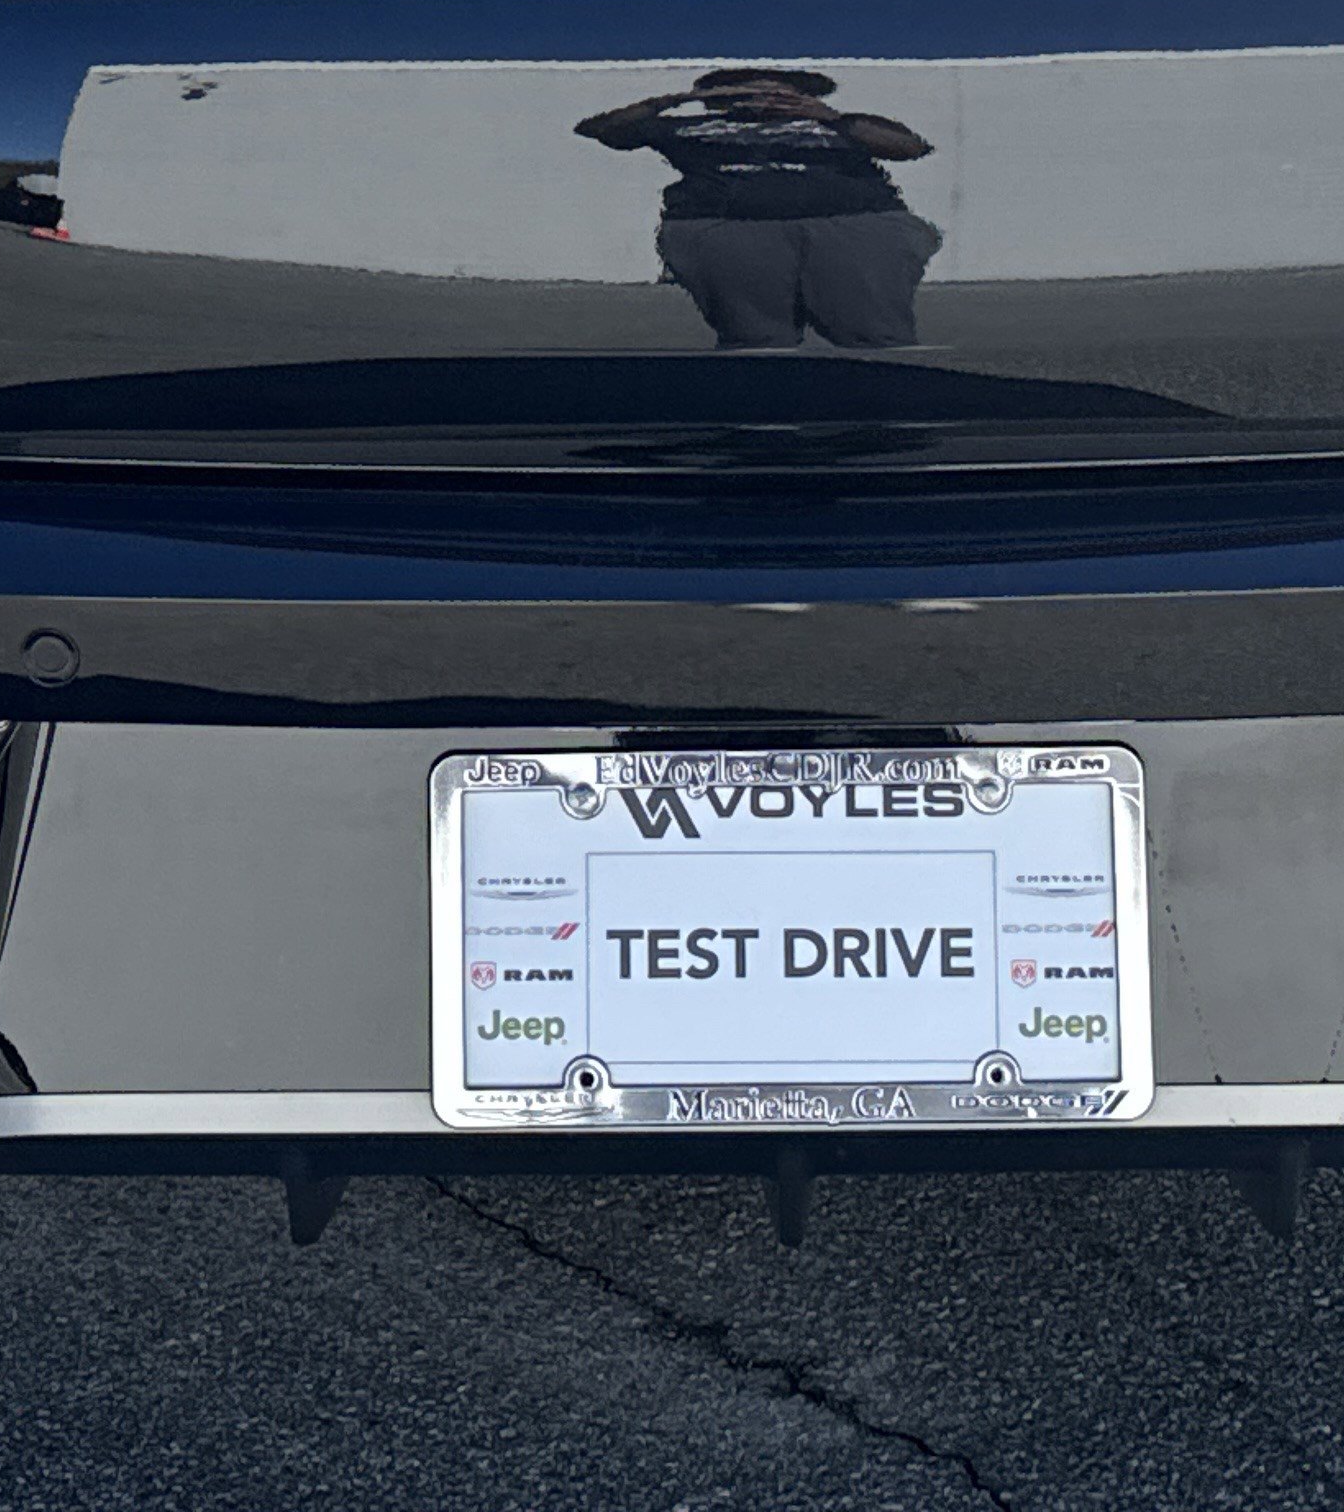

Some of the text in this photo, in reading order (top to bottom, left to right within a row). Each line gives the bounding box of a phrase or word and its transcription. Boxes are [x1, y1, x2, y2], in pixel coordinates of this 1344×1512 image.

[463, 755, 543, 787] Jeep
[594, 751, 961, 799] EdVoylesCDJR.com
[1030, 756, 1109, 773] RAM
[706, 785, 965, 818] VOYLES
[1015, 874, 1105, 884] CHRYSLER
[606, 926, 975, 979] TEST DRIVE
[503, 968, 575, 982] RAM
[1043, 966, 1115, 980] RAM
[477, 1008, 566, 1046] Jeep
[1017, 1006, 1108, 1044] Jeep
[667, 1085, 918, 1124] Marietta, GA
